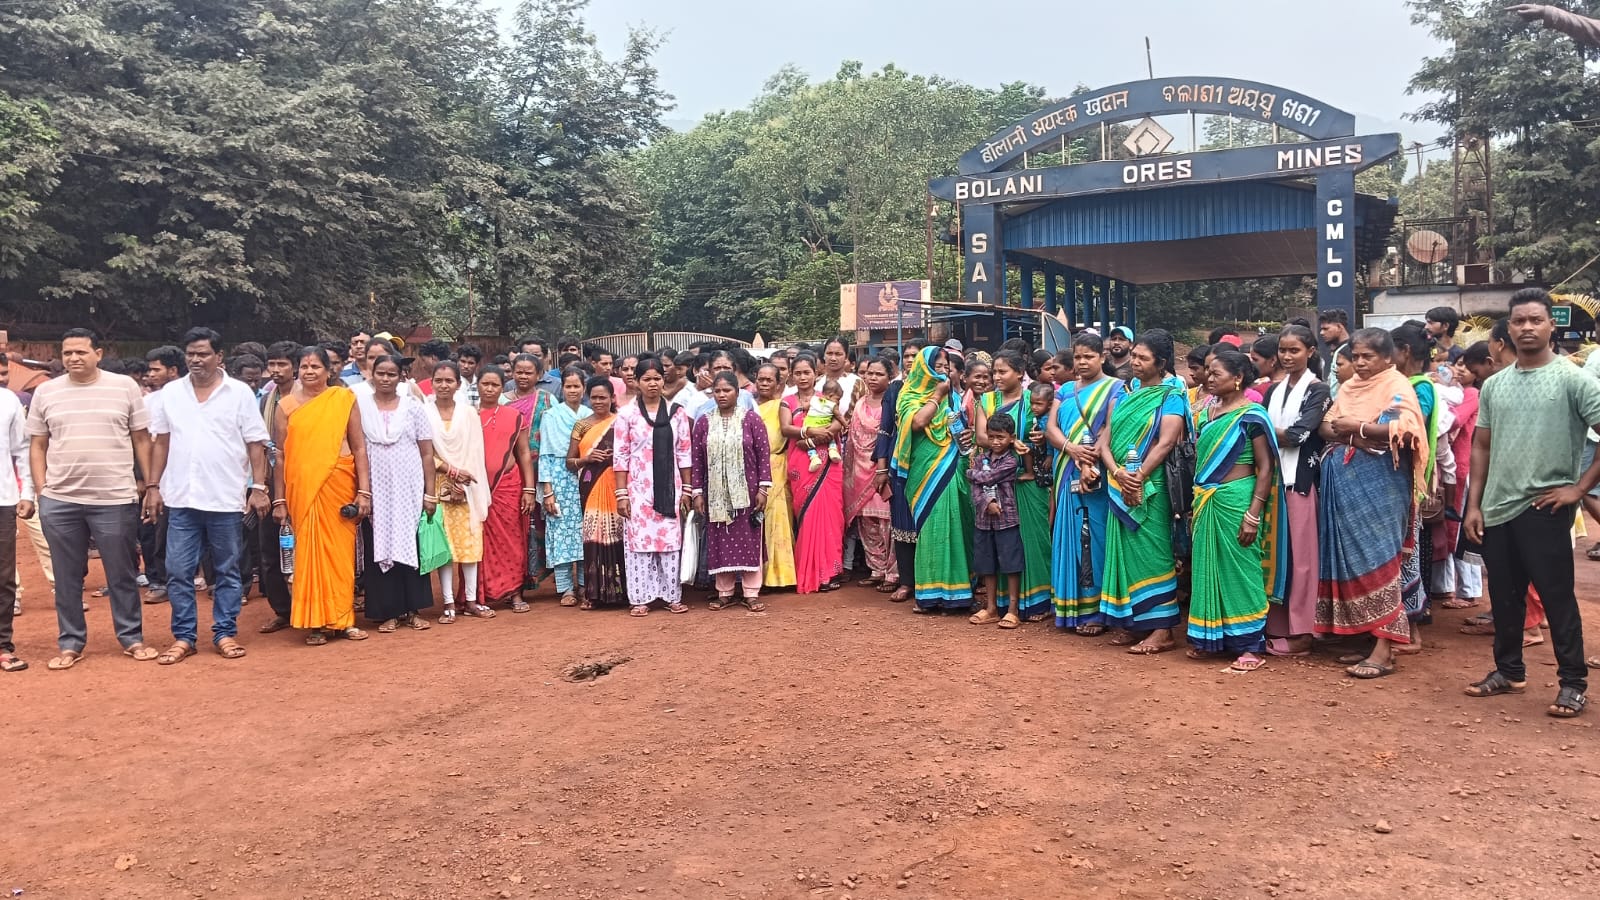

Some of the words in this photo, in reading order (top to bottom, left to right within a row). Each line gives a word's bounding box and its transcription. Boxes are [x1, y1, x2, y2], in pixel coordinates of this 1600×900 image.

[980, 126, 1028, 163] बोलानी
[1083, 90, 1129, 116] खदान
[955, 174, 1043, 200] BOLANI
[1122, 159, 1192, 184] ORES
[1277, 143, 1362, 170] MINES
[1326, 199, 1344, 288] CMLO
